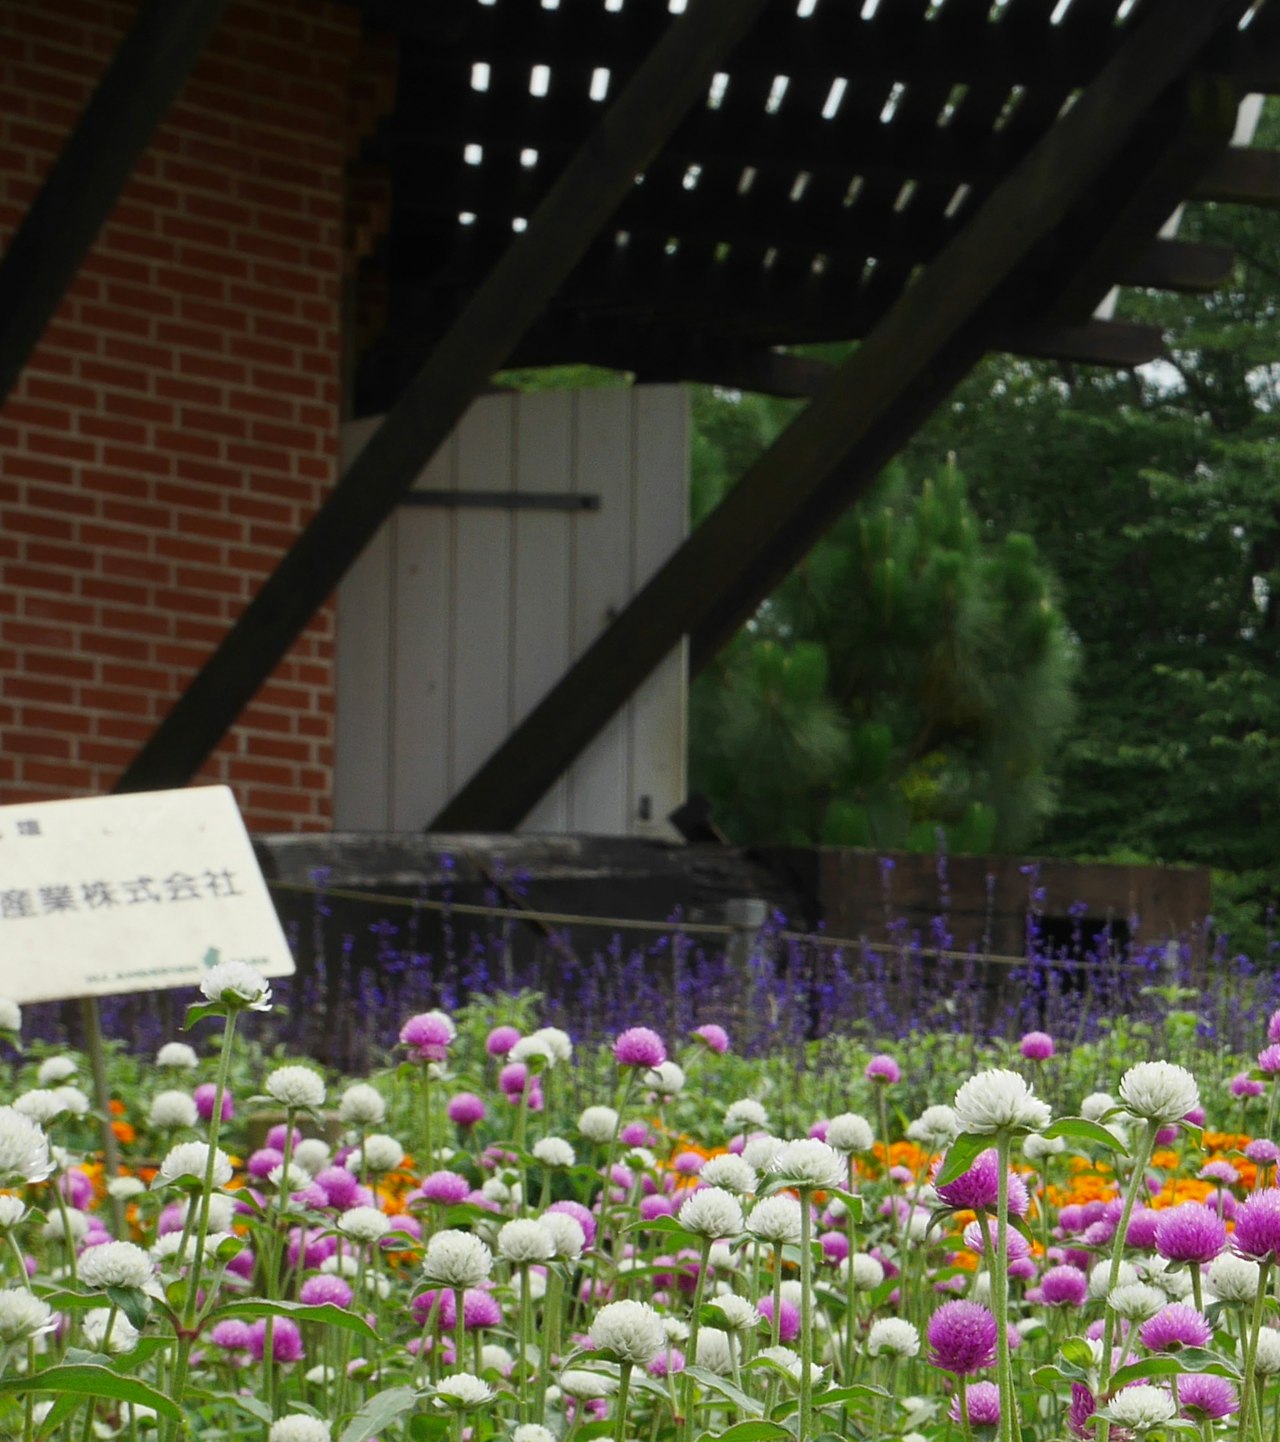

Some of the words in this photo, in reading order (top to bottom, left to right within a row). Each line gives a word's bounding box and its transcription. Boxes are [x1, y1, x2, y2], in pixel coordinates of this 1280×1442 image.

[0, 868, 243, 919] 産業株式会社
